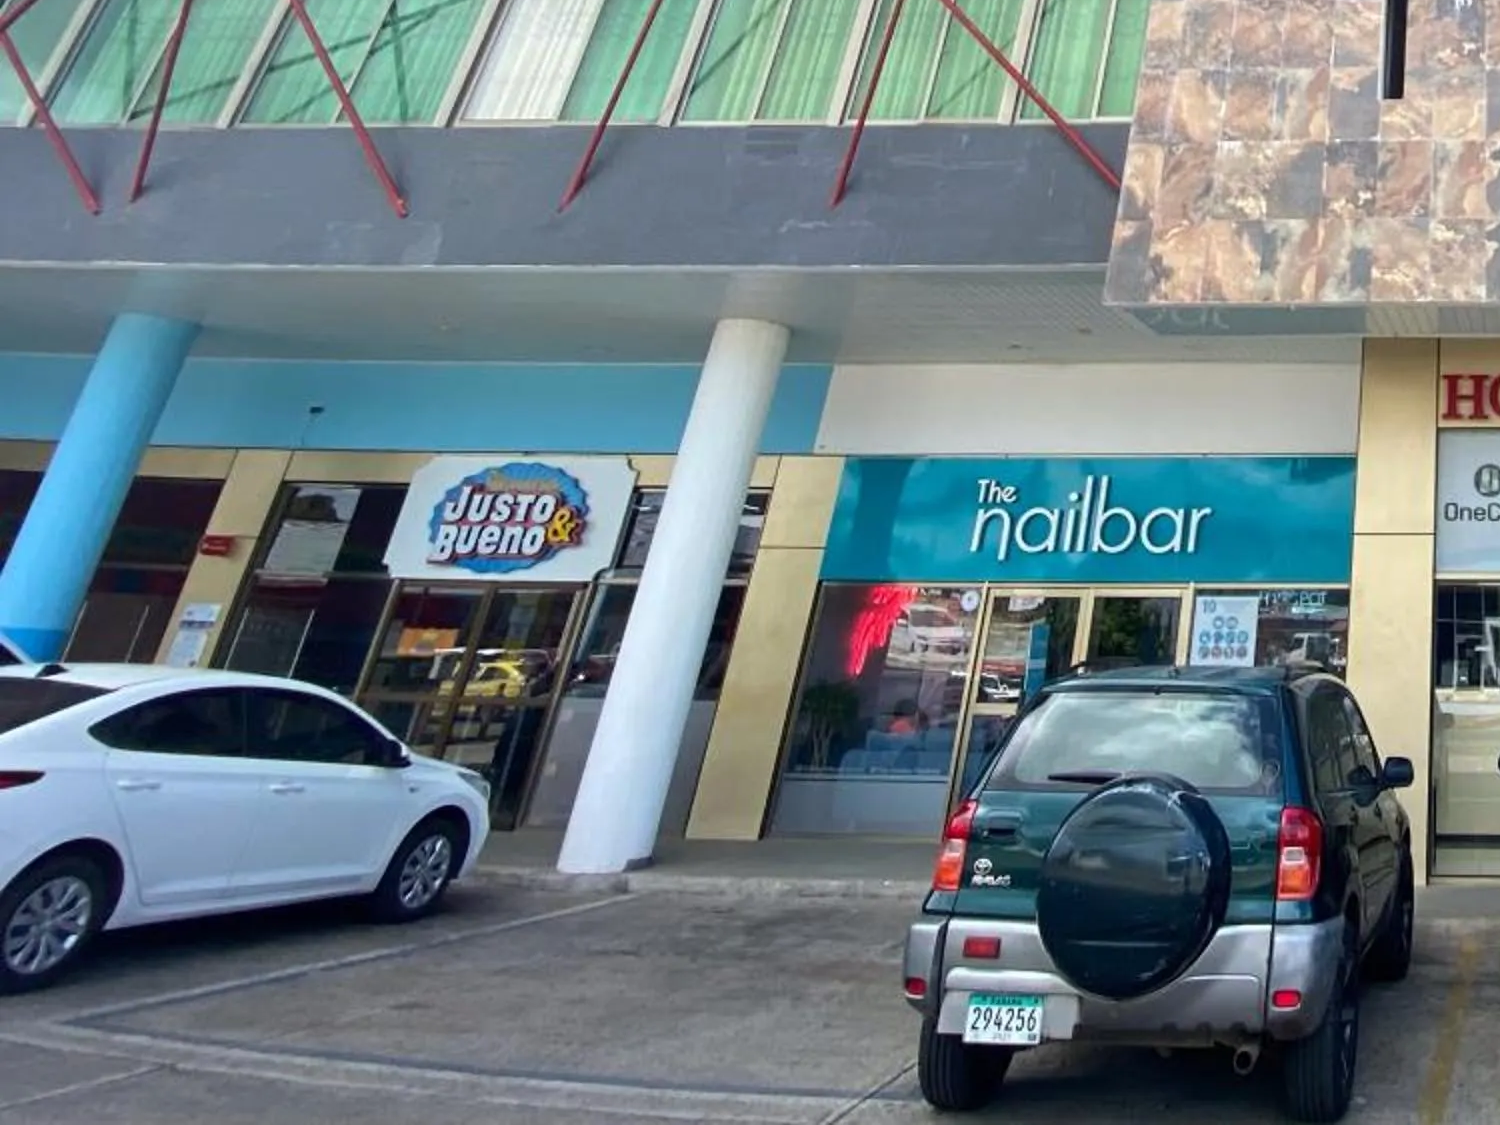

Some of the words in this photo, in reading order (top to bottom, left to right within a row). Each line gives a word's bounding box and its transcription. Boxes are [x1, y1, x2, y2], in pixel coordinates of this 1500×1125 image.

[976, 478, 1018, 504] The
[545, 505, 581, 544] &
[969, 475, 1213, 562] nailbar
[971, 1006, 1038, 1032] 294256
